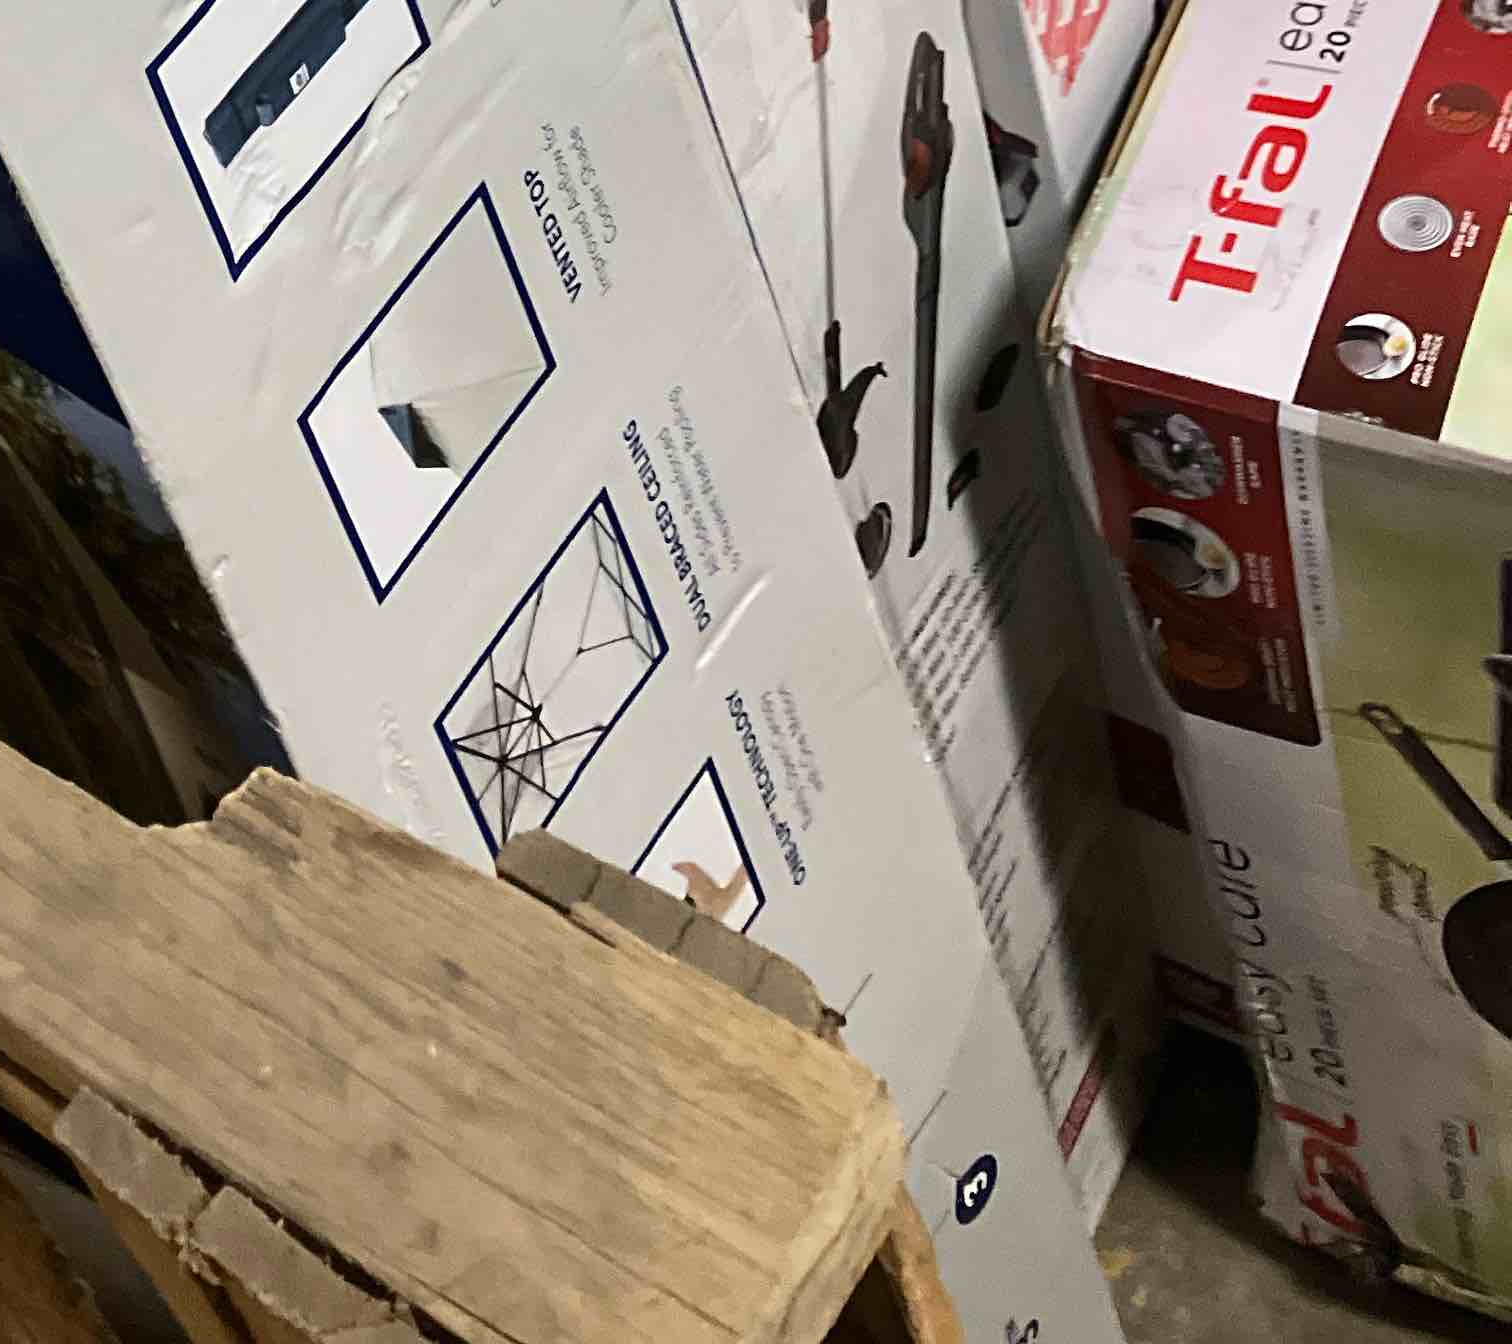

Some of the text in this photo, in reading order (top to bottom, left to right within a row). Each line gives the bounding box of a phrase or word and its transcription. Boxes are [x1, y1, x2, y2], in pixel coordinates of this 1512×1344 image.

[1318, 29, 1354, 64] 20
[1168, 83, 1333, 302] T-fal
[521, 167, 586, 304] VENTED TOP
[619, 419, 665, 503] CEILING
[650, 499, 695, 582] BRACED
[679, 574, 715, 633] DUAL
[723, 689, 781, 811] TECHNOLOGY
[956, 1169, 996, 1210] 3
